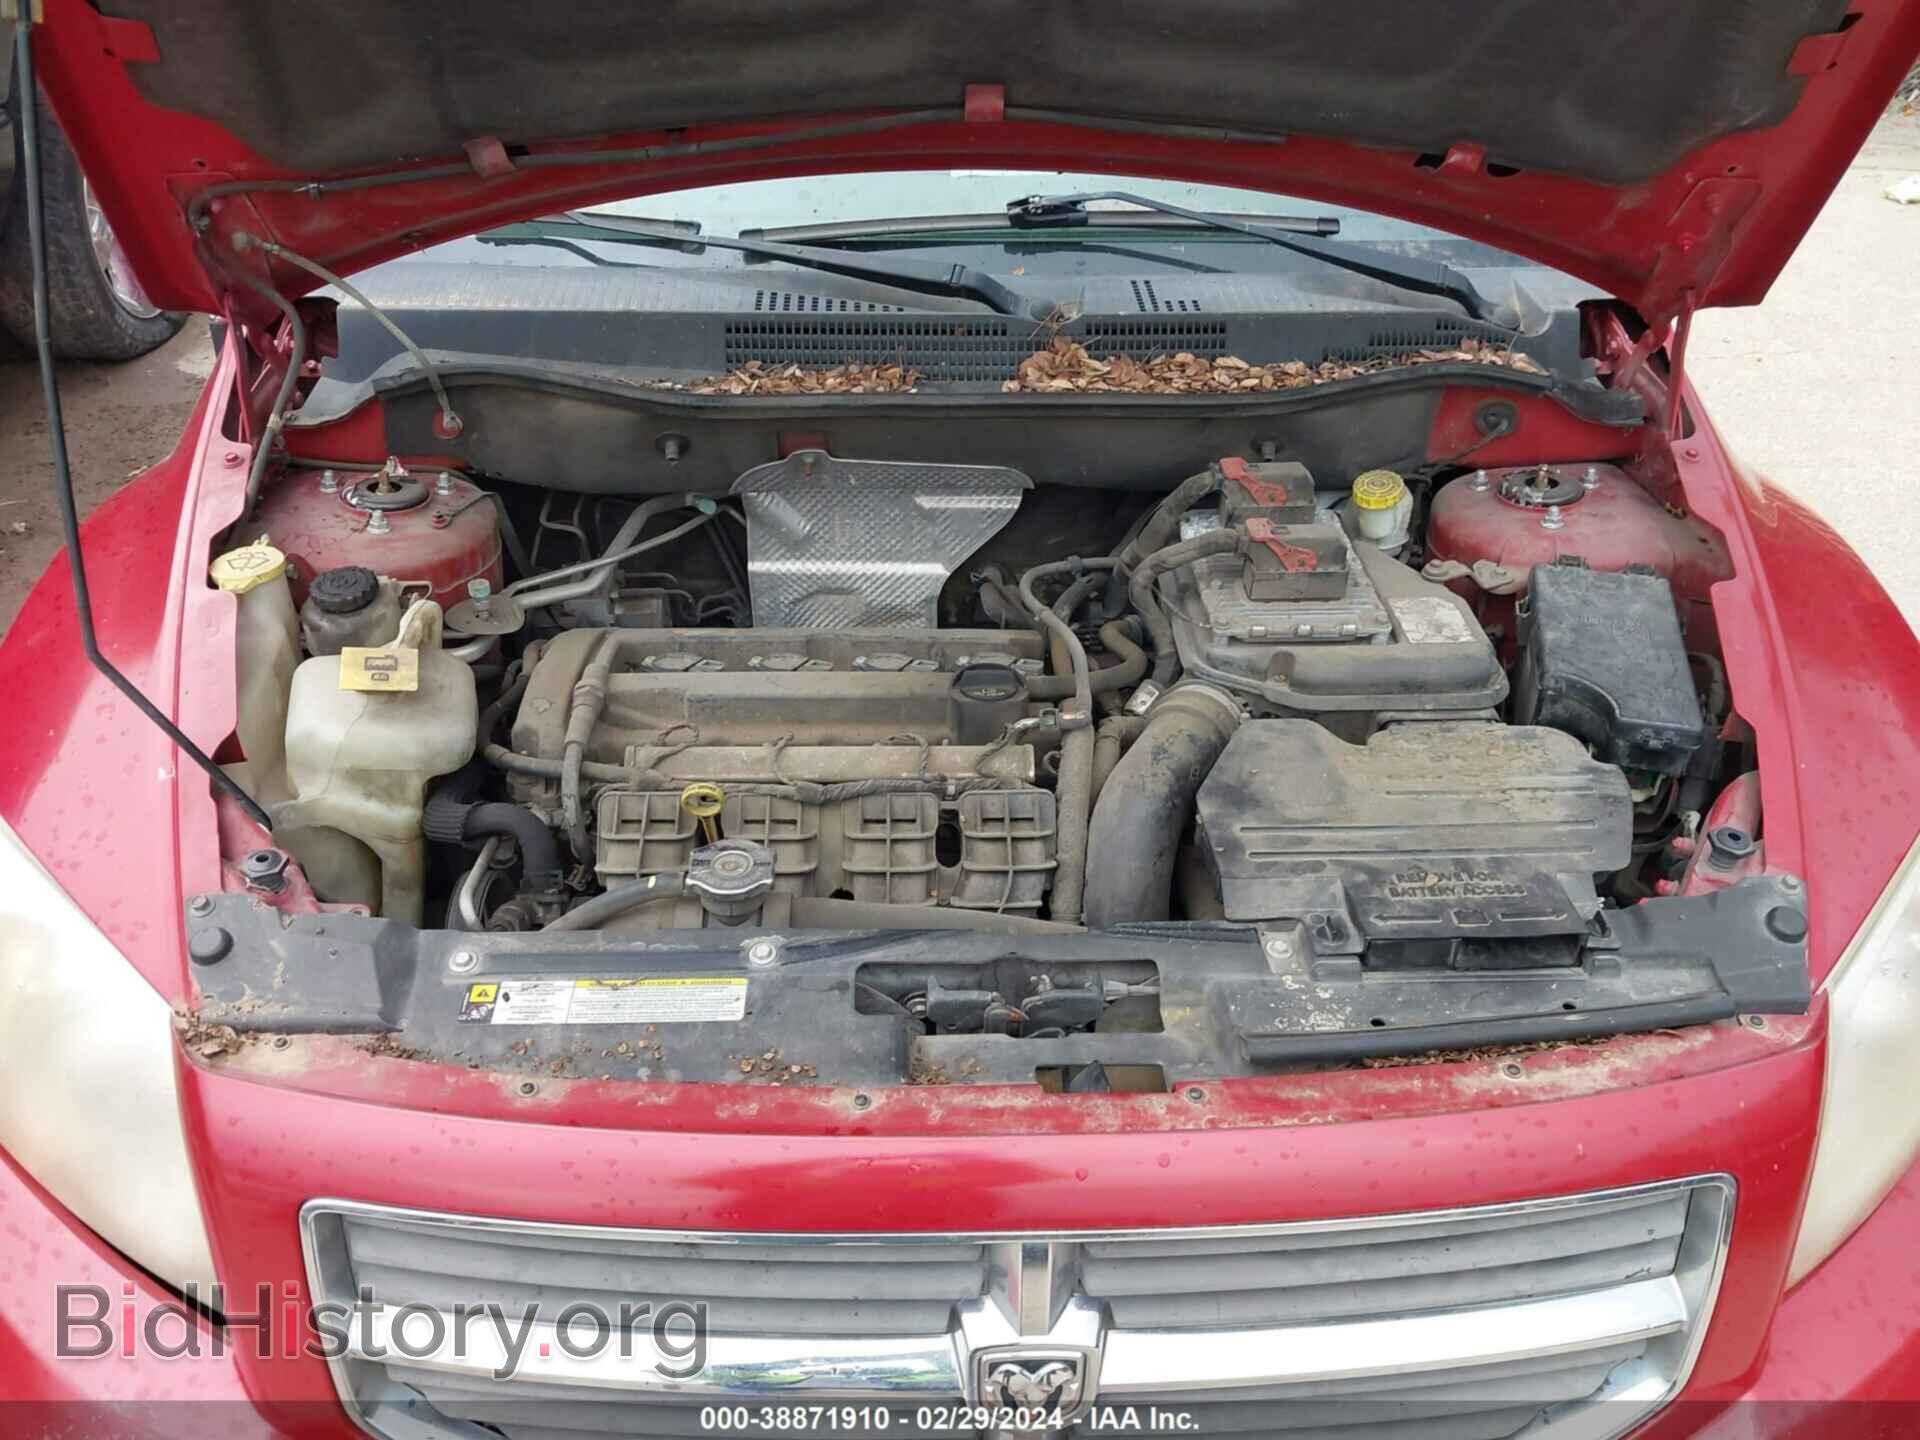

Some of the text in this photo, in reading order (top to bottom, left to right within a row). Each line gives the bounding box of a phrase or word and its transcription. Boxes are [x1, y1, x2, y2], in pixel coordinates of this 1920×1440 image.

[1395, 870, 1501, 882] REMVE FOR
[1389, 883, 1525, 898] BATTERY ACCESS
